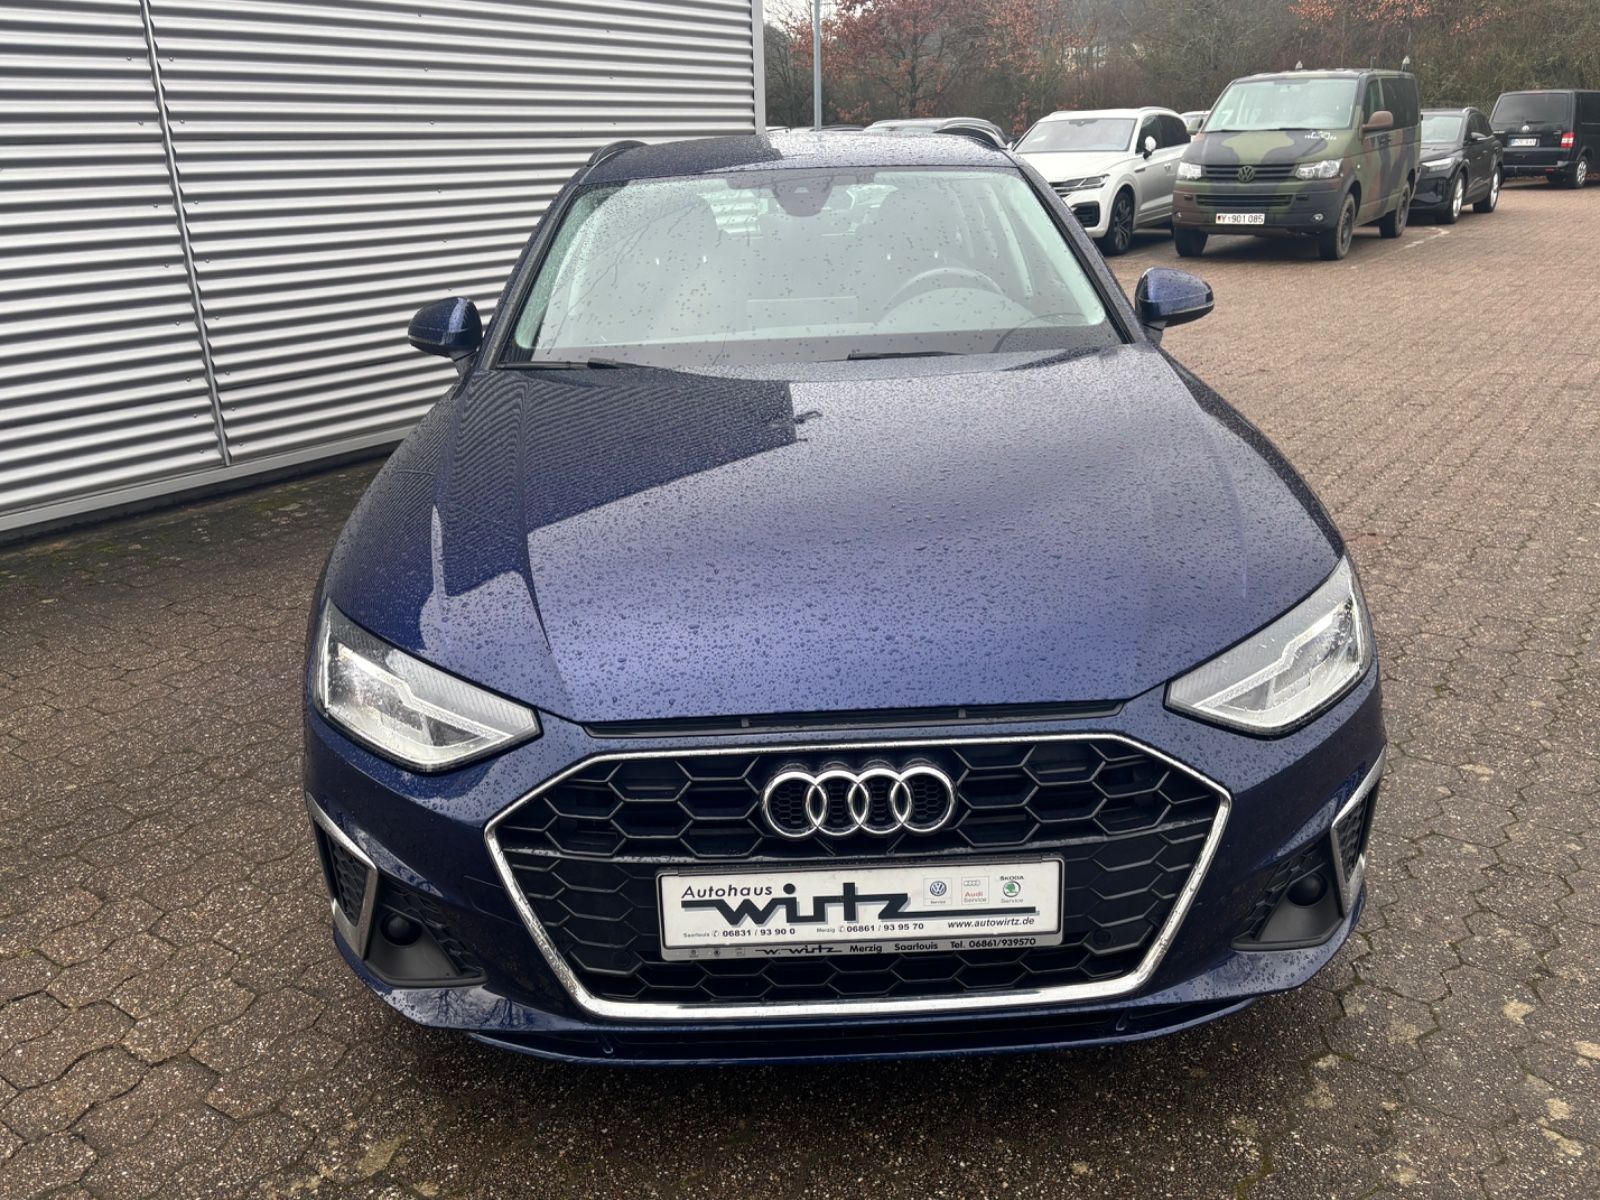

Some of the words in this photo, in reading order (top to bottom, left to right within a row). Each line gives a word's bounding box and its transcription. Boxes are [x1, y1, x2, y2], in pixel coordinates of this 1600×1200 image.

[1231, 214, 1246, 223] 901
[1248, 214, 1264, 223] 085
[681, 884, 773, 899] Autohaus
[846, 924, 876, 933] 06861
[883, 924, 896, 932] 93
[898, 923, 910, 931] 95
[912, 922, 925, 930] 70
[947, 917, 1035, 929] www.autowirtz.de
[722, 929, 752, 938] 06831
[760, 928, 772, 936] 93
[774, 928, 786, 936] 90
[789, 927, 796, 935] 0
[849, 944, 883, 954] Merzig
[894, 942, 939, 951] Saarlouis
[950, 940, 966, 949] Tel.
[968, 937, 1037, 948] 06861/939570
